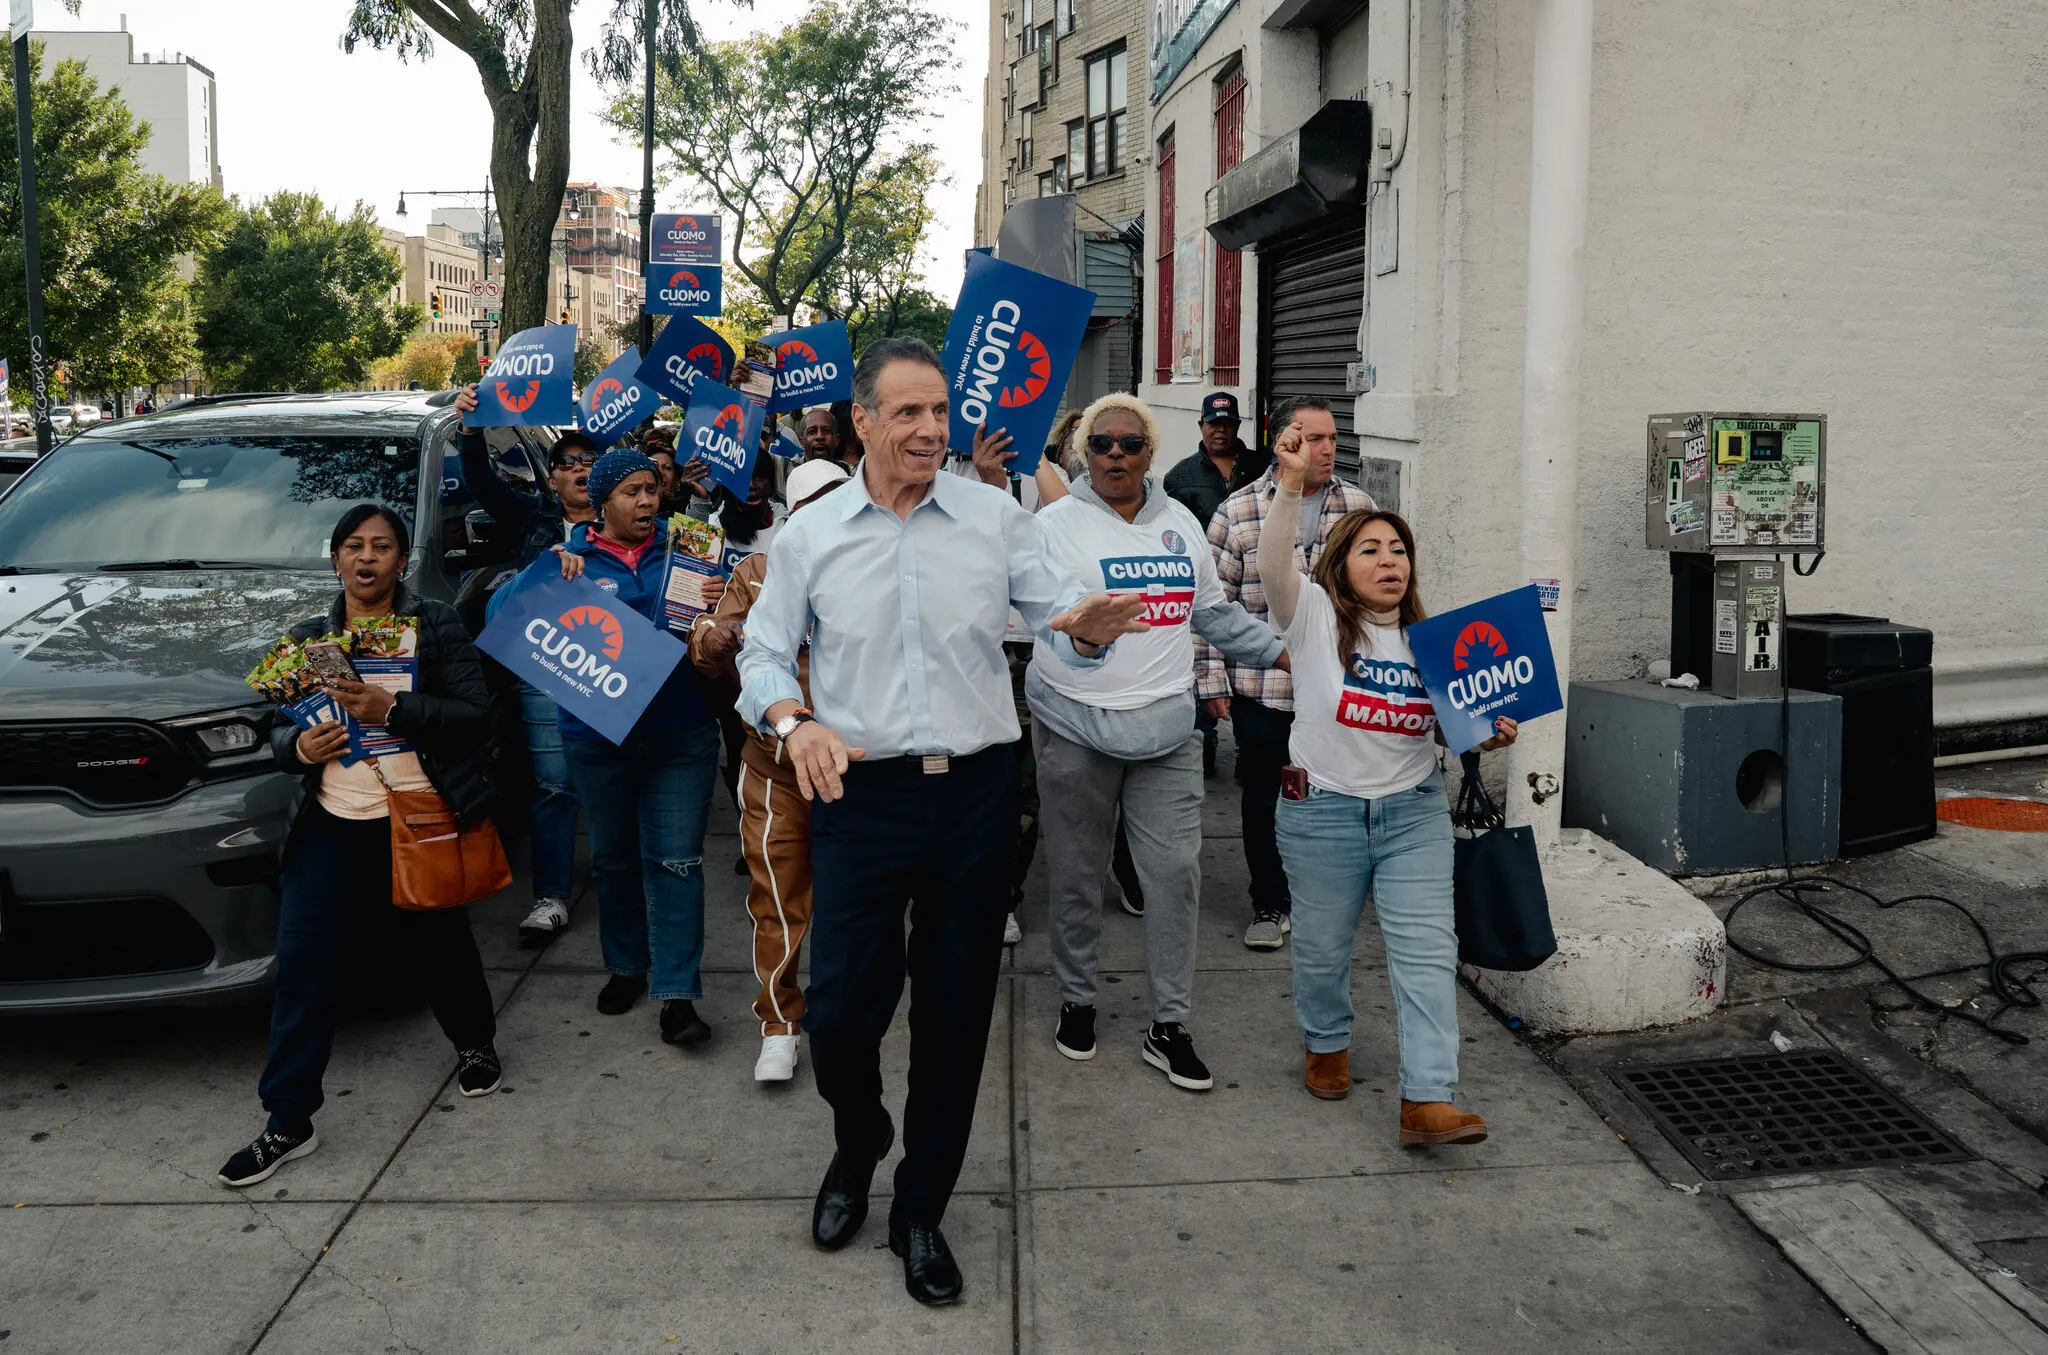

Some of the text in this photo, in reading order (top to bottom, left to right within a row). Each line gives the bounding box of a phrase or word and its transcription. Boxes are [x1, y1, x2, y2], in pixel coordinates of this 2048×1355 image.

[668, 230, 706, 240] CUOMO
[660, 289, 710, 302] CUOMO
[976, 315, 984, 324] to
[968, 325, 982, 347] build
[486, 353, 554, 378] CUOMO
[666, 355, 704, 387] CUO
[960, 354, 970, 372] new
[961, 300, 1020, 424] CUOMO
[775, 362, 838, 390] UOMO
[955, 372, 966, 391] NYC
[786, 388, 799, 397] build
[586, 386, 640, 433] CUOMO
[607, 421, 616, 432] build
[625, 408, 634, 416] NYC
[1737, 421, 1797, 430] DIGITAL AIR
[695, 426, 746, 469] CUOMO
[707, 453, 720, 465] build
[1109, 561, 1191, 579] CUOMO
[1134, 602, 1190, 620] AYOR
[1754, 620, 1770, 669] AIR
[525, 618, 628, 698] CUOMO
[531, 652, 540, 660] to
[539, 656, 558, 673] build
[562, 673, 578, 687] new
[576, 682, 594, 697] NYC
[1352, 660, 1423, 688] CUOM
[1448, 656, 1534, 710] CUOMO
[1474, 704, 1486, 716] build
[1490, 699, 1504, 709] new
[1504, 692, 1519, 704] NYC
[1345, 703, 1437, 730] MAYOR
[77, 759, 139, 767] DODGE
